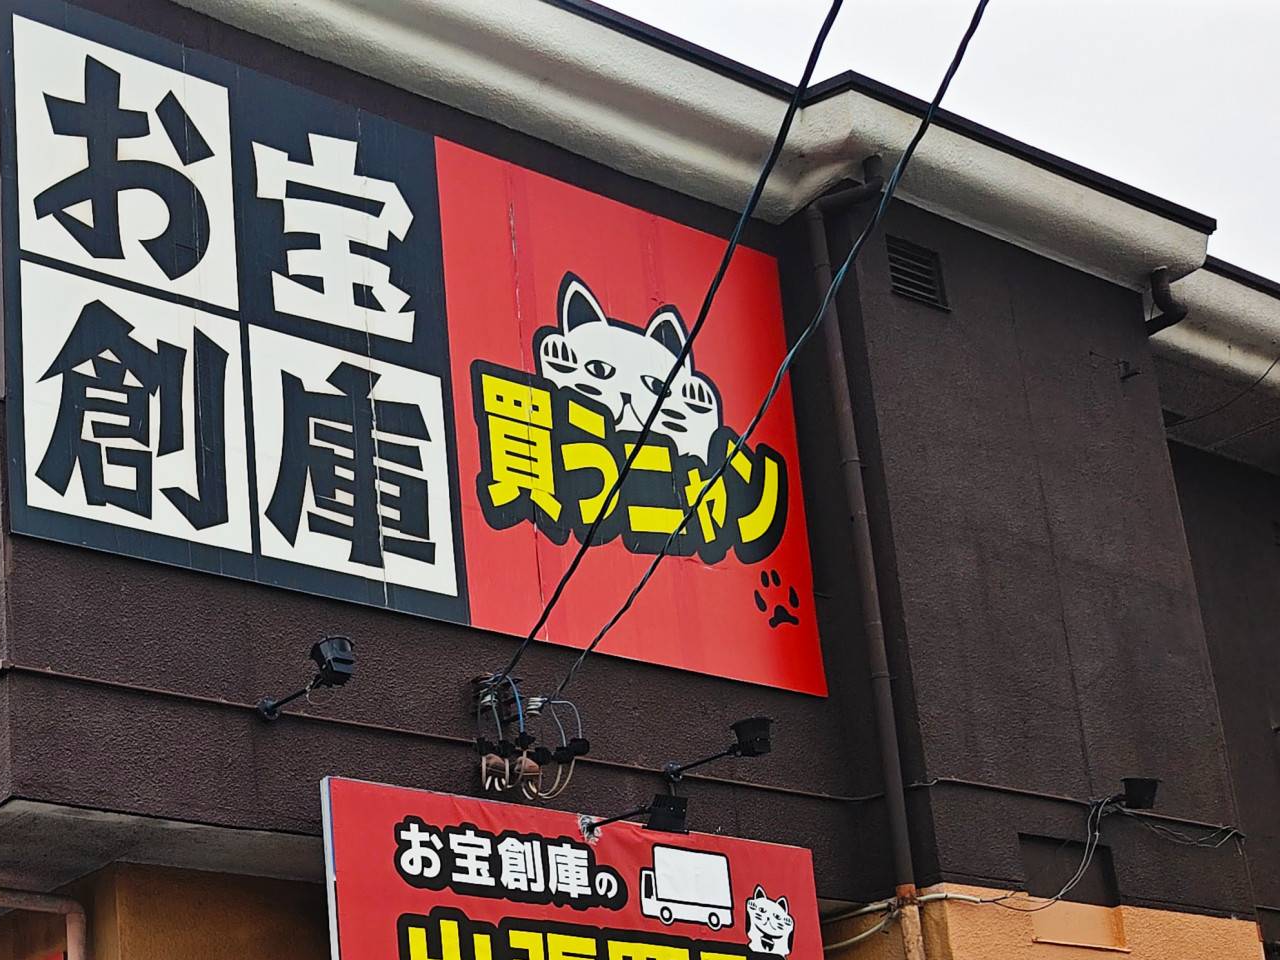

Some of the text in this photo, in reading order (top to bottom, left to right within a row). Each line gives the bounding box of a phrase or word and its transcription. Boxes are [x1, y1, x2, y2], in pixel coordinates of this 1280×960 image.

[34, 54, 417, 343] お宝
[36, 299, 437, 568] 創庫
[481, 372, 781, 542] 買うニャン
[398, 822, 619, 900] お宝創庫の
